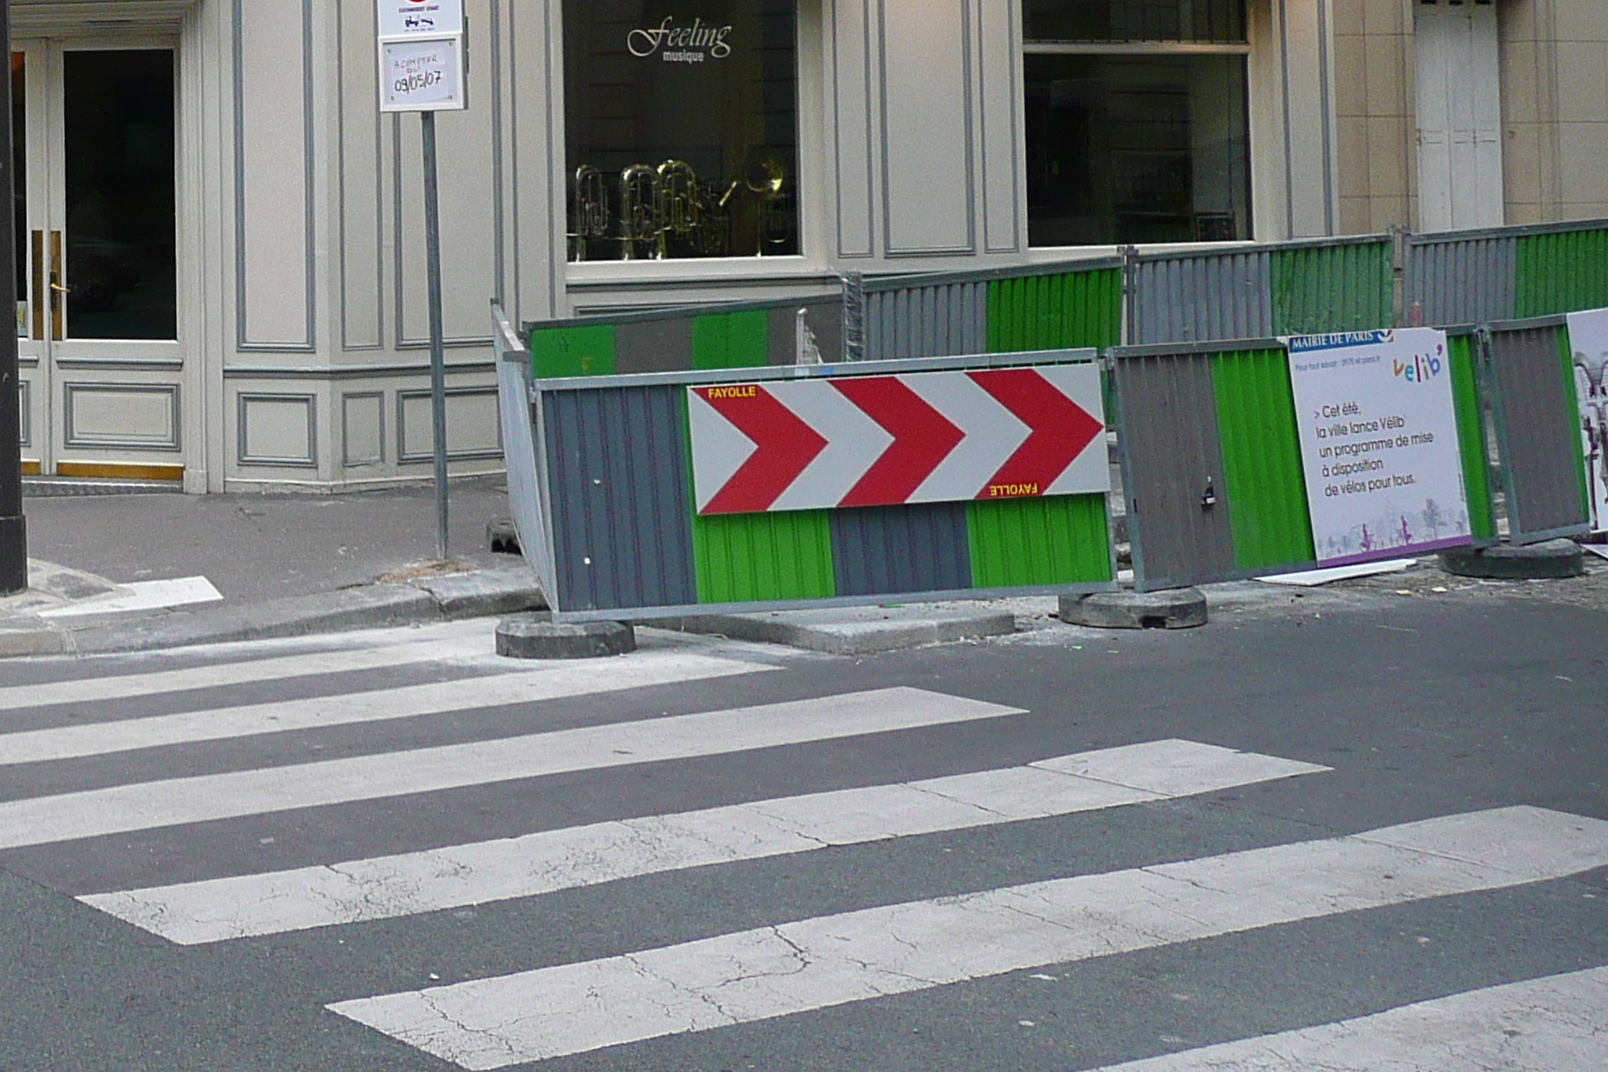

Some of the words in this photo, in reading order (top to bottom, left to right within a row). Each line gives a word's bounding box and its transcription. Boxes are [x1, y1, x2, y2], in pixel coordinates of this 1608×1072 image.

[627, 15, 733, 59] Feeling
[662, 49, 705, 64] musique
[394, 70, 442, 95] 09/05/07
[1293, 333, 1328, 349] MAIRIE
[1329, 332, 1344, 345] DE
[1345, 330, 1375, 343] PARIS
[708, 385, 757, 399] FAYOLLE
[1322, 404, 1340, 419] Cet
[1315, 426, 1327, 440] la
[1328, 423, 1348, 437] ville
[1349, 420, 1379, 434] lance
[1318, 446, 1332, 458] un
[1334, 438, 1394, 459] programme
[1395, 433, 1409, 448] de
[1410, 431, 1434, 446] mise
[1331, 457, 1384, 477] disposition
[989, 482, 1039, 496] FAYOLLE
[1324, 482, 1339, 497] de
[1340, 479, 1367, 495] vélos
[1368, 476, 1391, 494] pour
